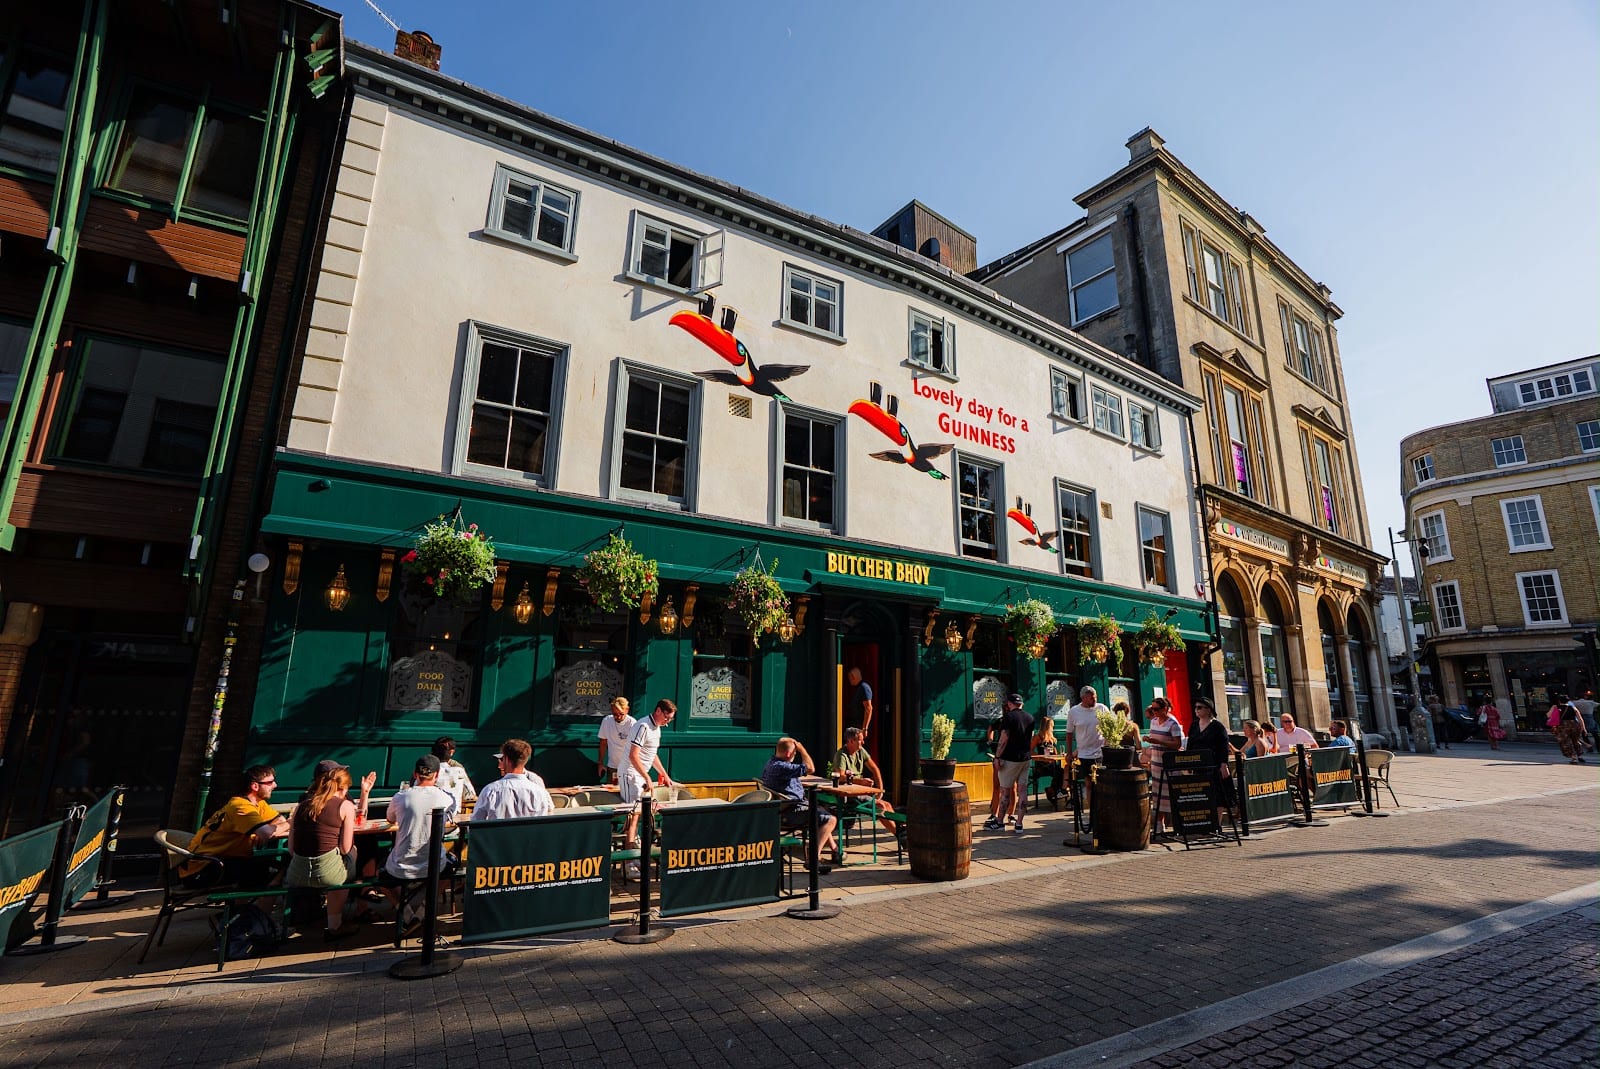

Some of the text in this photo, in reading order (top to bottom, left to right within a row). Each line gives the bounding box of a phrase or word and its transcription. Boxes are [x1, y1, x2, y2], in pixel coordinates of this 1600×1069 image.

[913, 377, 1030, 432] Lovely day for a
[938, 412, 1016, 454] GUINNESS
[827, 551, 931, 586] BUTCHER BHOY
[416, 682, 444, 690] DAILY
[419, 672, 445, 680] FOOD
[576, 680, 602, 689] GOOD
[1248, 782, 1274, 797] BUTCHER
[1273, 778, 1288, 793] BHOY
[667, 839, 775, 869] BUTCHER BHOY
[475, 855, 604, 889] BUTCHER BHOY
